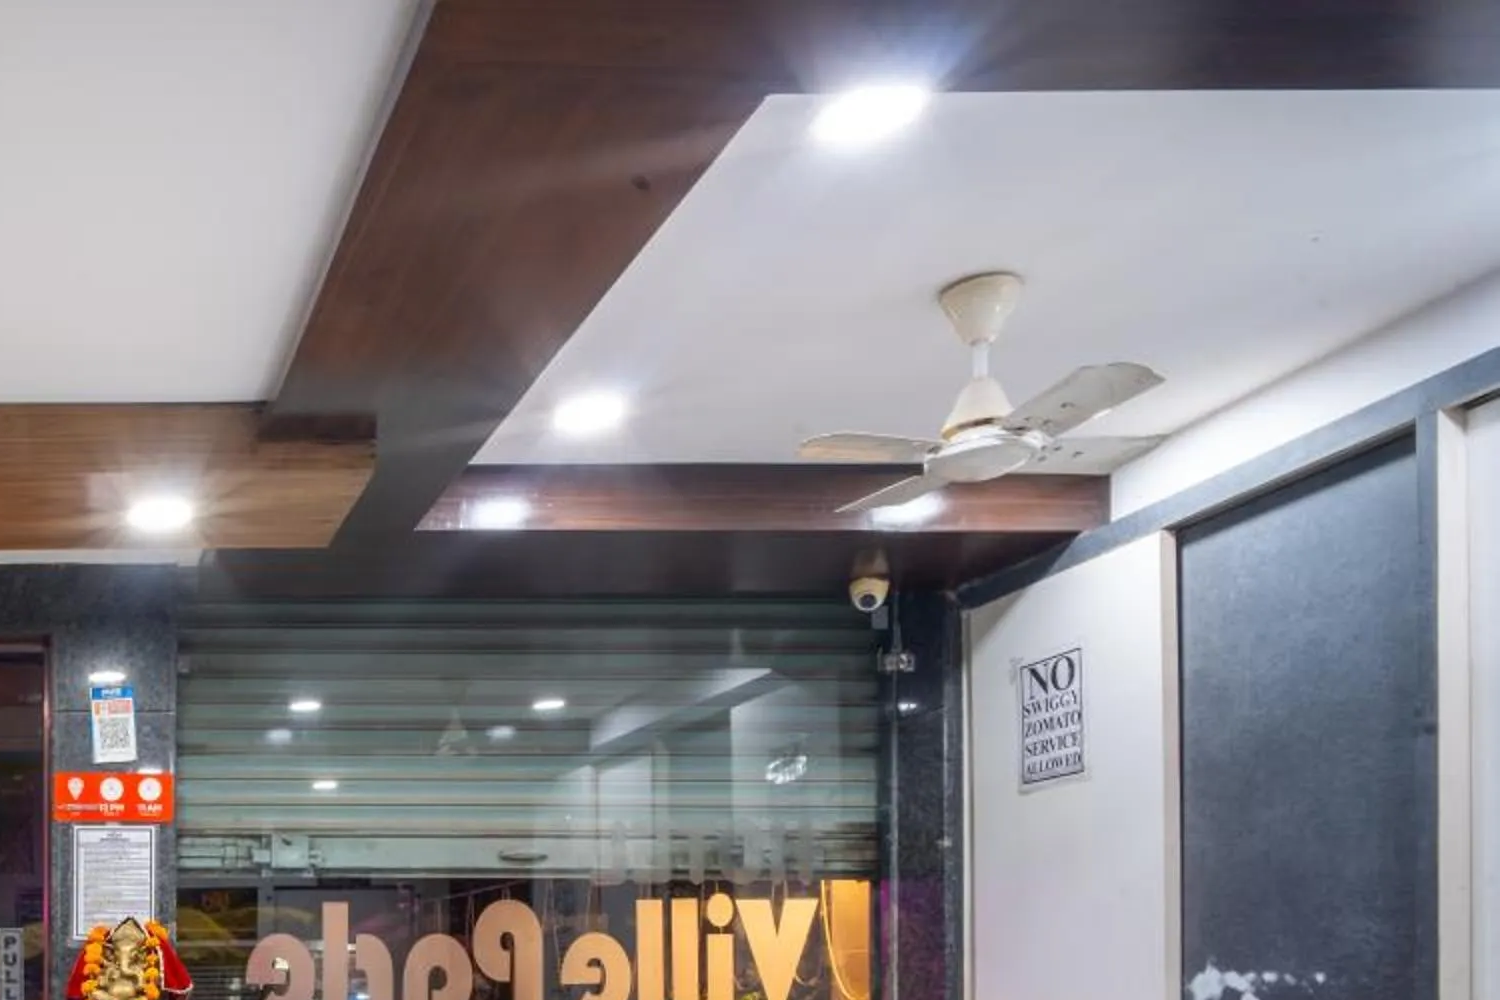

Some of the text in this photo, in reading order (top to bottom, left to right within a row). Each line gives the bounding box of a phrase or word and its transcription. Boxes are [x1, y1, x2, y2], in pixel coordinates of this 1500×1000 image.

[1027, 655, 1076, 700] NO
[1023, 689, 1078, 719] SWIGGY
[1025, 711, 1081, 738] ZOMATO
[1025, 732, 1079, 757] SERVICE
[1025, 753, 1081, 775] ALLOWED
[3, 935, 18, 1000] PULL
